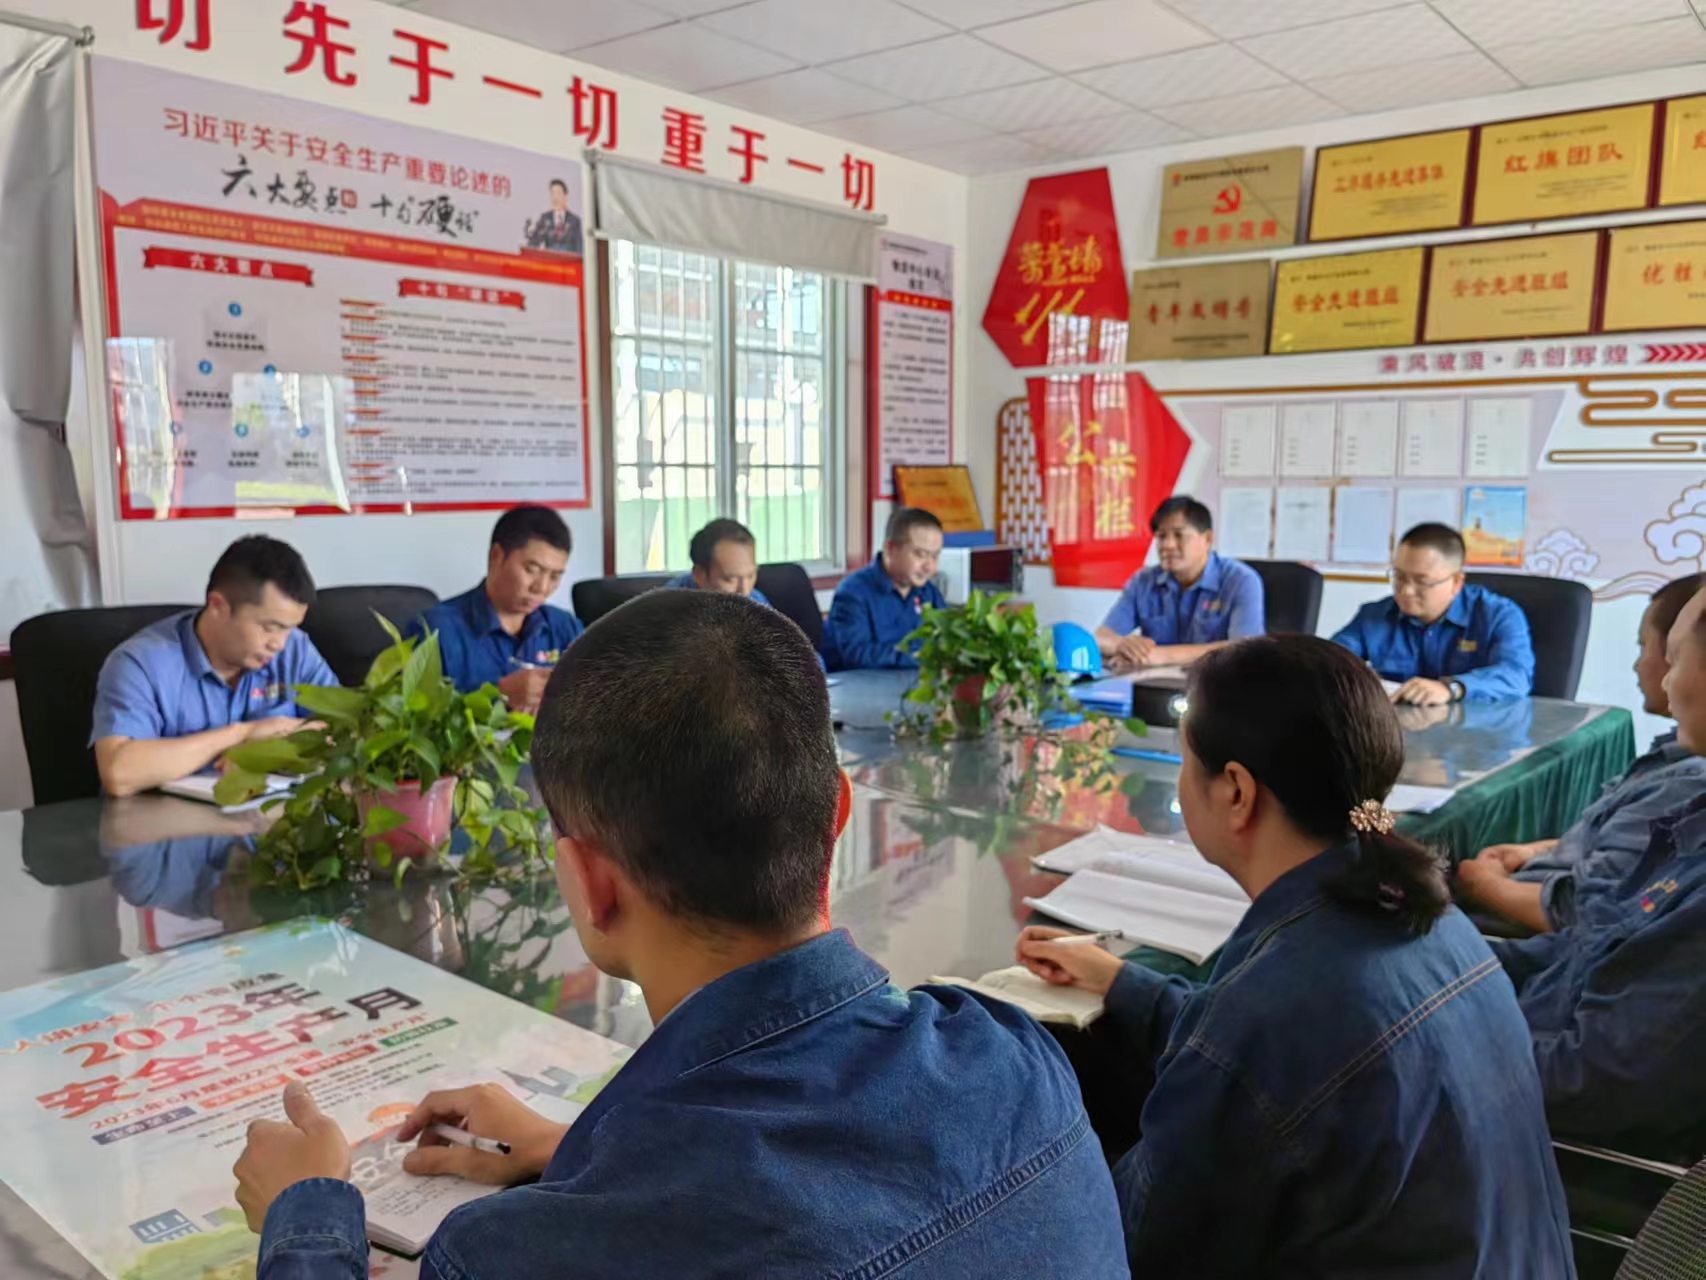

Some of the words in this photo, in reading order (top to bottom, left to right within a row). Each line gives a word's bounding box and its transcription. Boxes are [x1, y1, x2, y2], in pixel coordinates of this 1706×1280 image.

[163, 107, 511, 198] 习近平关于安全生产重要论述的
[662, 107, 876, 212] 重于一切
[36, 986, 422, 1119] 安全生产月
[62, 982, 321, 1068] 2023年
